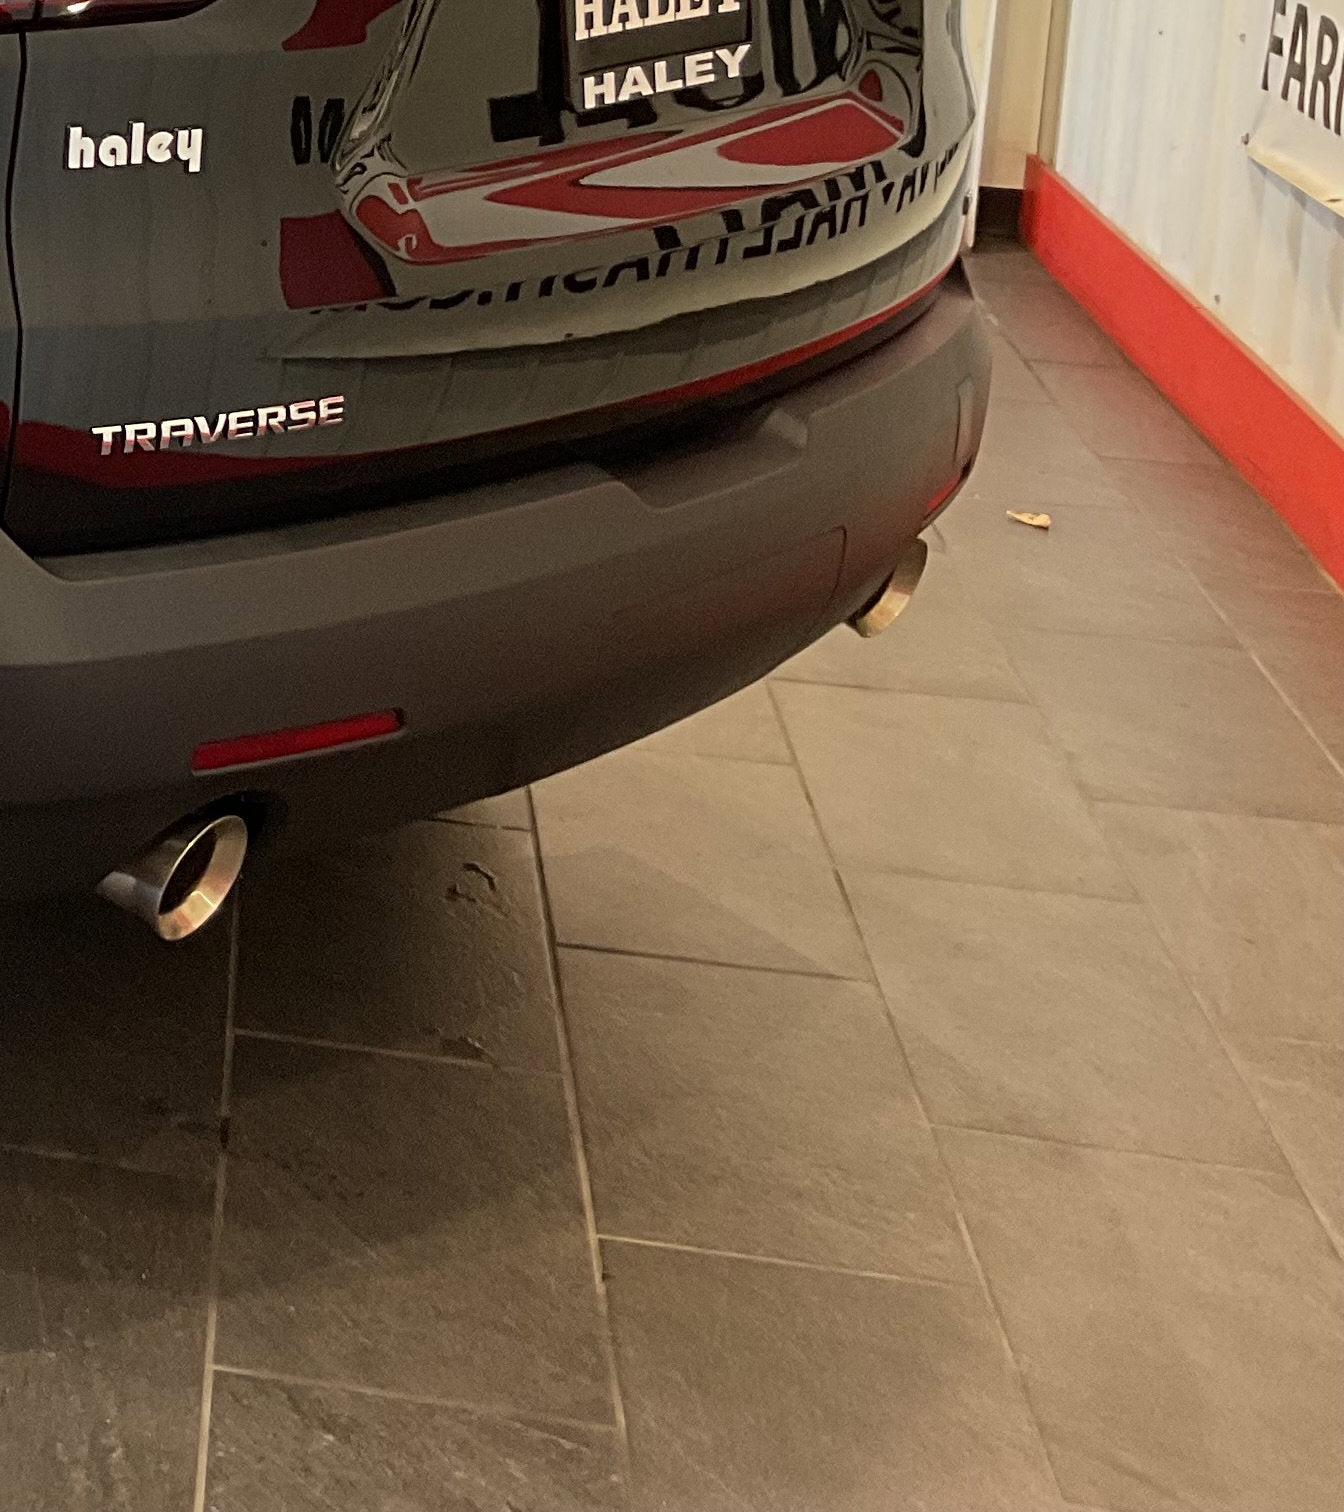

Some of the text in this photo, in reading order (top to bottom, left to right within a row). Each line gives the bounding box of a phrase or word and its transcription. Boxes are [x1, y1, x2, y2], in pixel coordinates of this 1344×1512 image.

[583, 44, 752, 110] HALEY
[67, 121, 203, 173] haley
[91, 395, 345, 456] TRAVERSE
